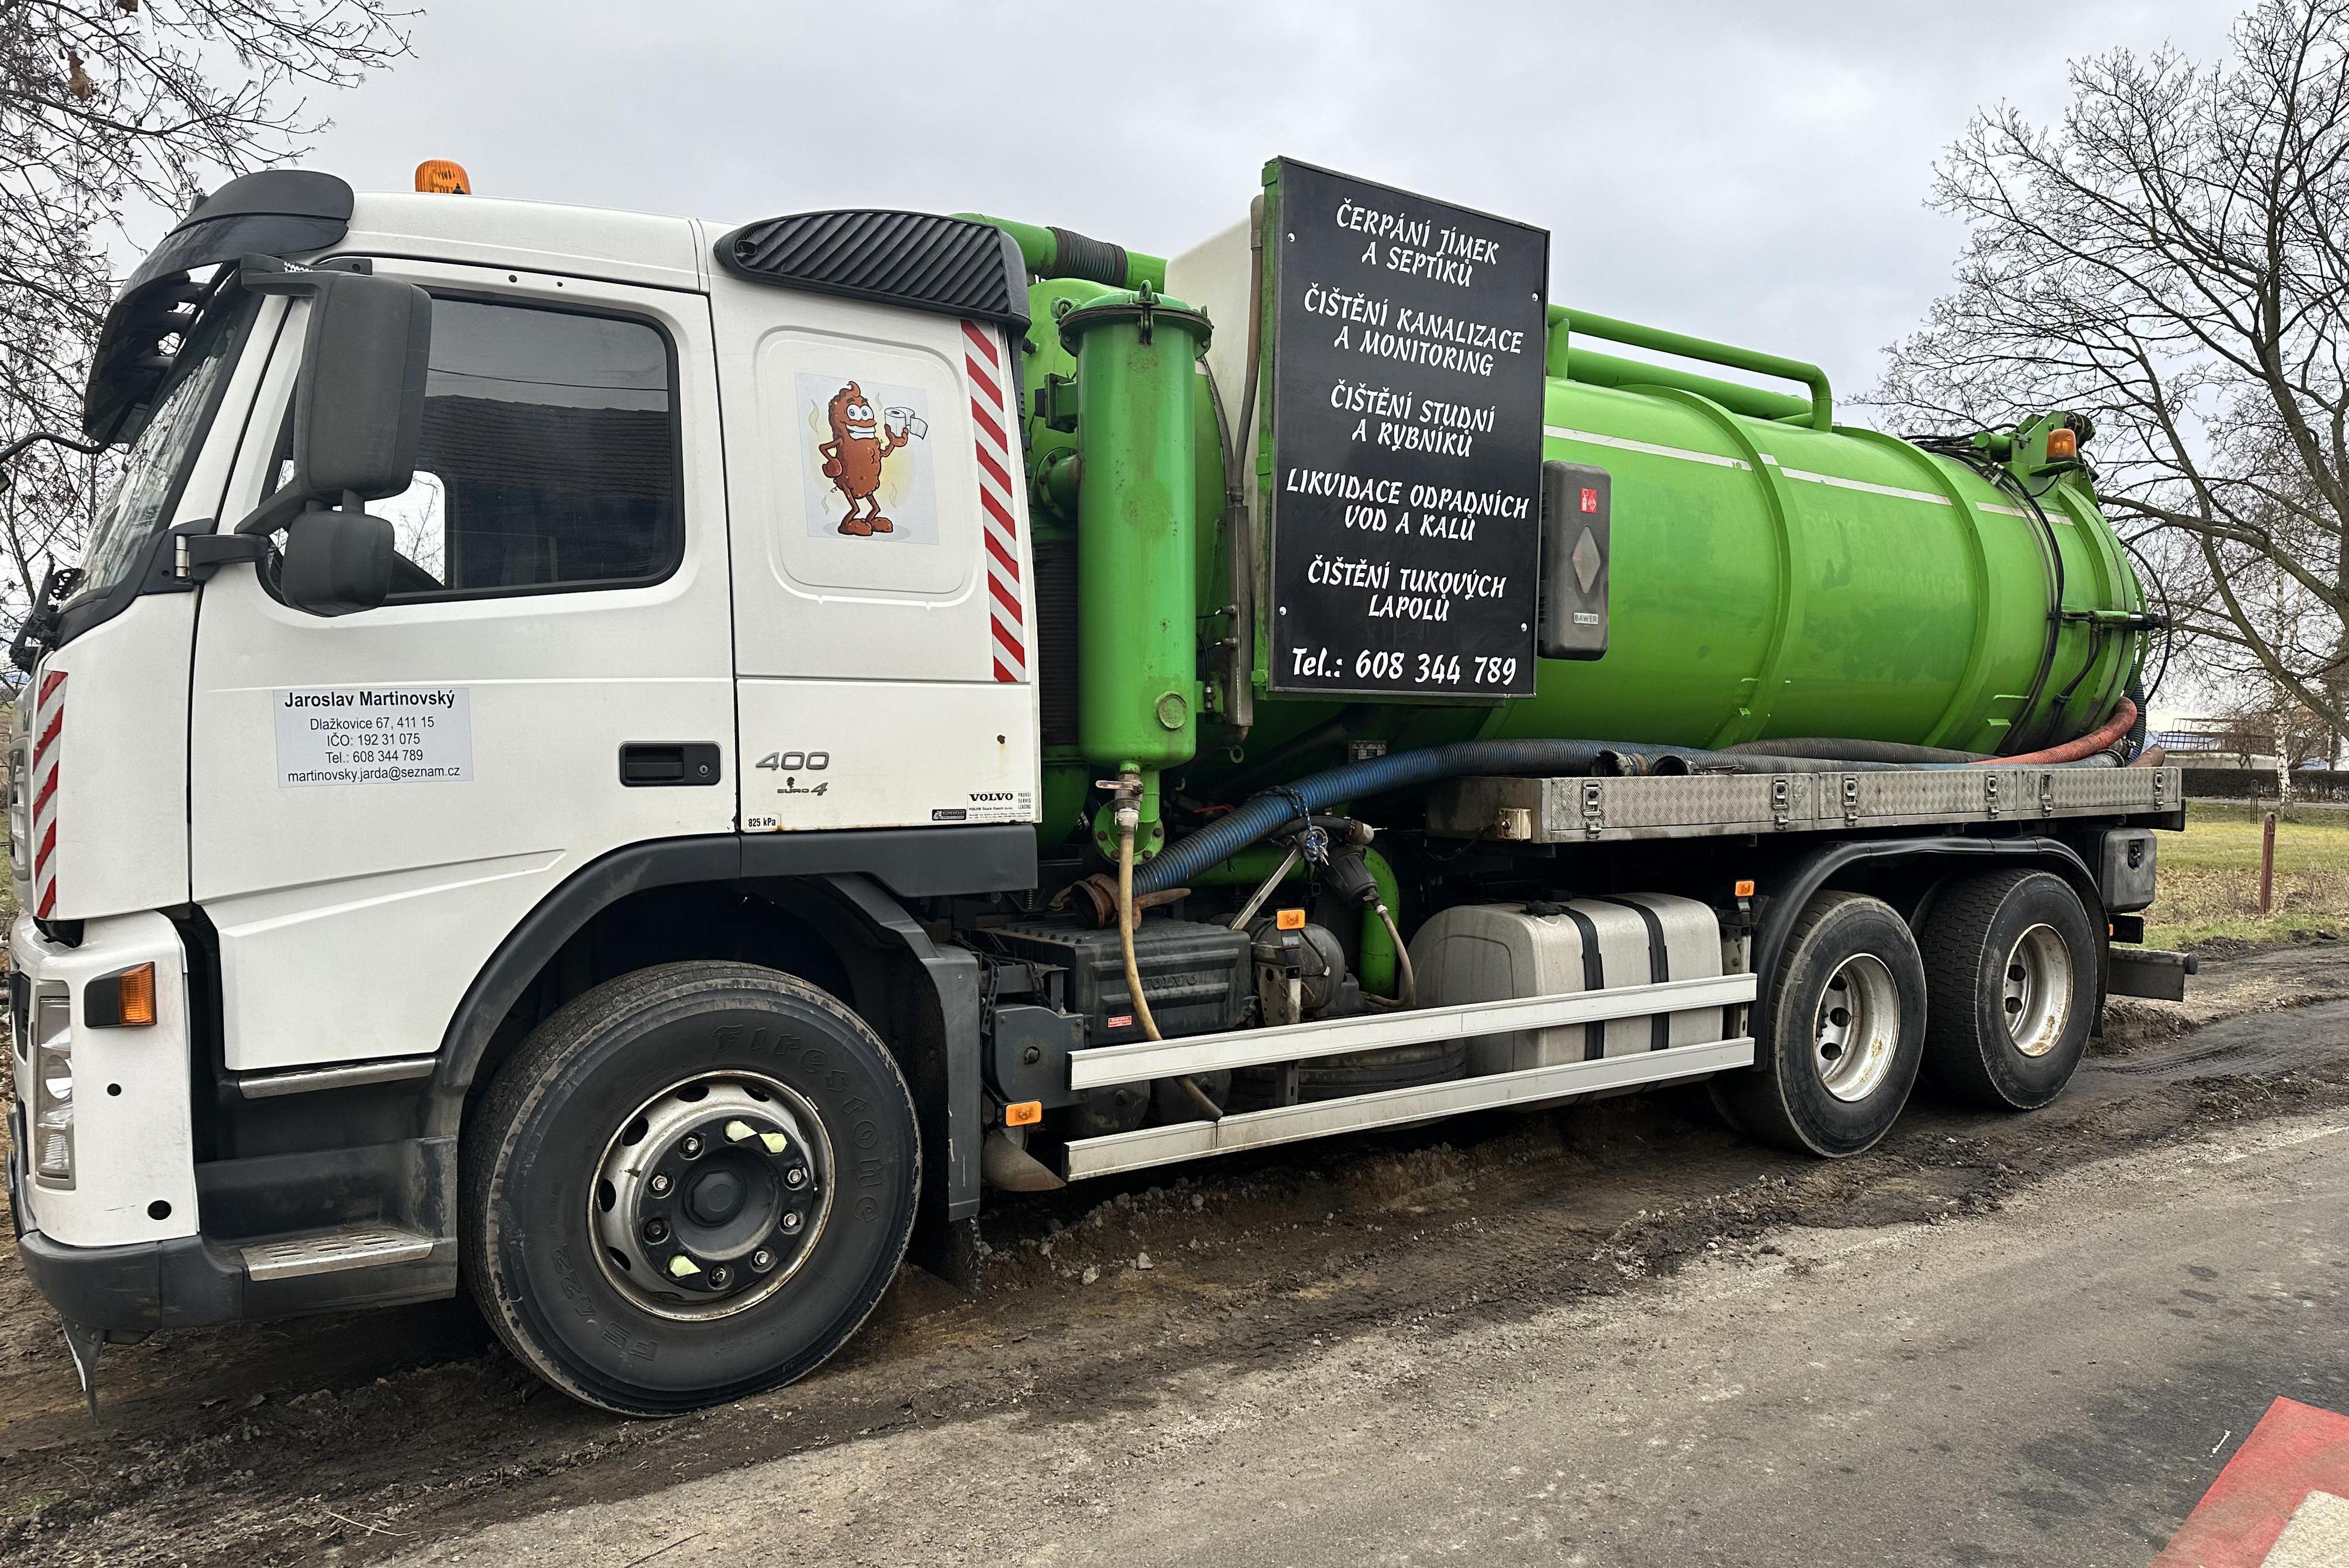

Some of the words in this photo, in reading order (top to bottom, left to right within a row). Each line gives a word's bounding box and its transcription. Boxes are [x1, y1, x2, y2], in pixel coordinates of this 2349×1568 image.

[1336, 198, 1431, 247] ČERPÁNÍ
[1437, 226, 1500, 264] JÍMEK
[1361, 242, 1377, 265] A
[1387, 246, 1473, 287] SEPTIKŮ
[1303, 282, 1388, 326] ČIŠTĚNÍ
[1397, 307, 1524, 354] KANALIZACE
[1334, 326, 1349, 350] A
[1359, 330, 1494, 376] MONITORING
[1331, 379, 1412, 419] ČIŠTĚNÍ
[1419, 400, 1496, 433] STUDNÍ
[1351, 419, 1367, 442] A
[1378, 422, 1473, 458] RYBNÍKŮ
[1286, 468, 1402, 505] LIKVIDACE
[1410, 484, 1530, 520] ODPADNÍCH
[1345, 505, 1388, 531] VOD
[1395, 512, 1410, 535] A
[1420, 512, 1475, 541] KALŮ
[1308, 554, 1390, 590] ČIŠTĚNÍ
[1400, 568, 1507, 600] TUKOVÝCH
[1368, 594, 1450, 621] LAPOLŮ
[1574, 614, 1597, 623] BAWER
[1292, 647, 1343, 677] Tel.:
[1355, 650, 1405, 680] 608
[1415, 653, 1461, 684] 344
[1474, 655, 1516, 686] 789
[284, 692, 354, 707] Jaroslav
[359, 690, 455, 708] Martinovský
[310, 717, 372, 730] Dlažkovice
[376, 717, 394, 730] 67,
[396, 717, 416, 729] 411
[421, 716, 434, 728] 15
[327, 732, 353, 746] IČO:
[358, 734, 378, 746] 192
[382, 733, 395, 745] 31
[399, 733, 420, 745] 075
[325, 752, 350, 763] Tel.:
[353, 750, 374, 763] 608
[378, 750, 398, 762] 344
[402, 749, 423, 761] 789
[755, 751, 829, 770] 400
[288, 766, 460, 782] martinovsky.jarda@seznam.cz
[969, 793, 1014, 802] VOLVO
[748, 818, 760, 827] 825
[763, 817, 776, 826] kPa
